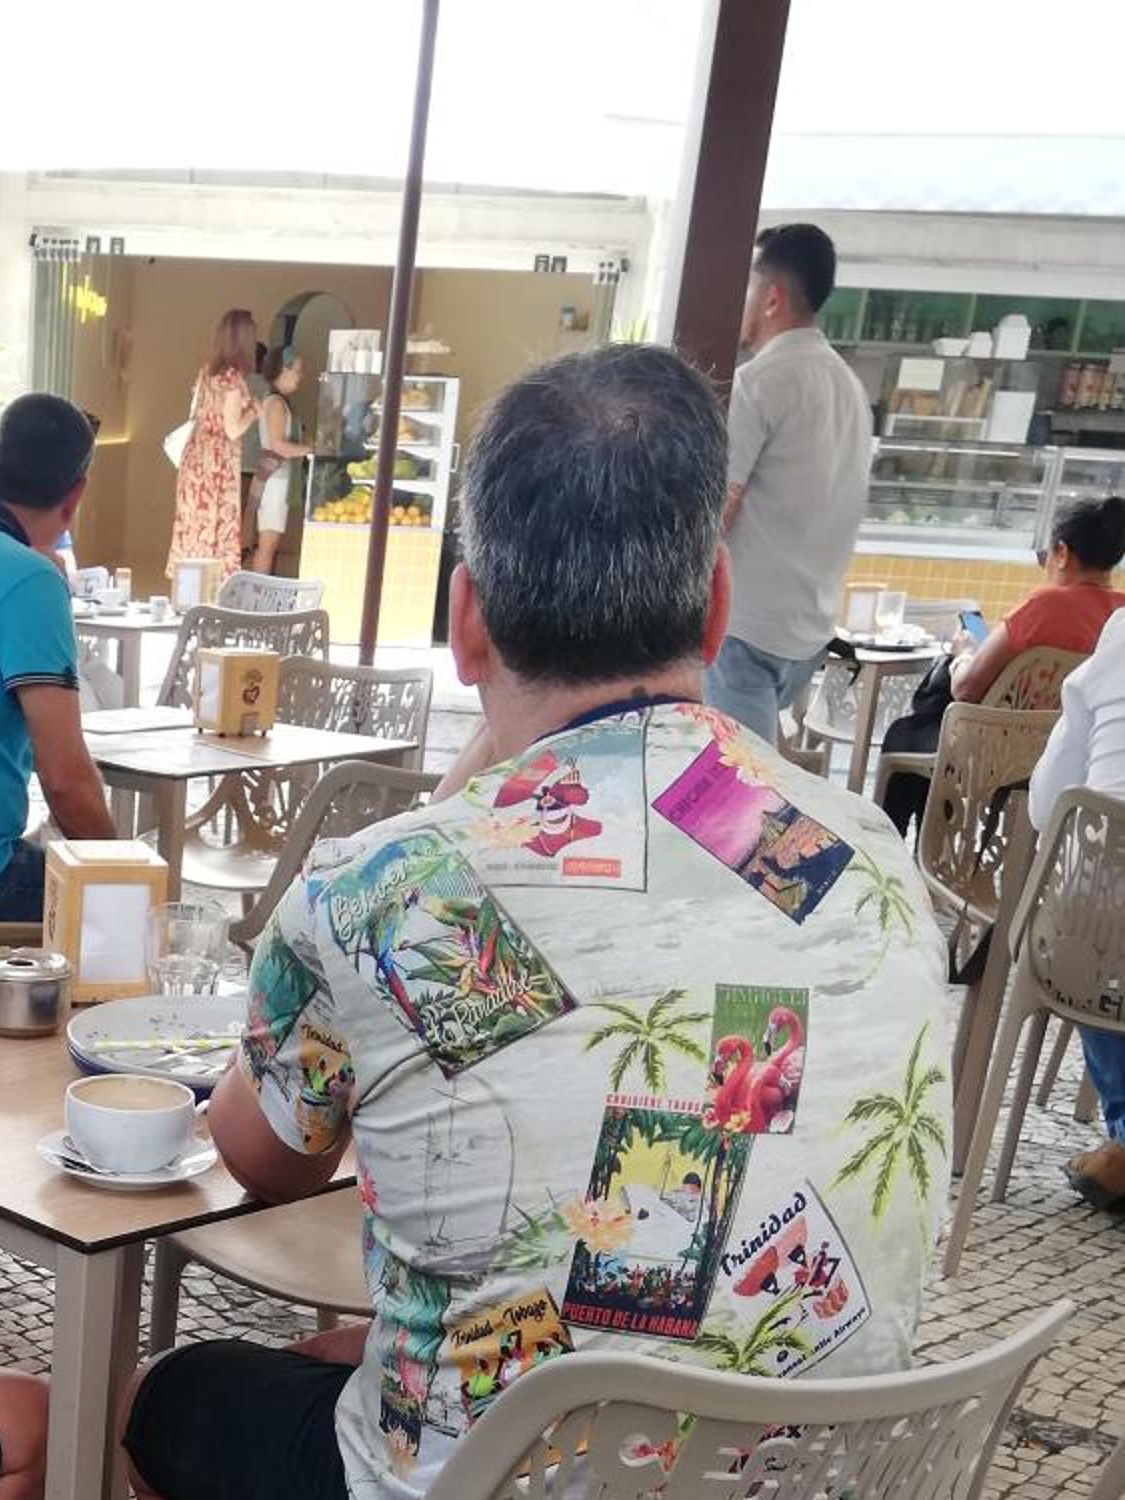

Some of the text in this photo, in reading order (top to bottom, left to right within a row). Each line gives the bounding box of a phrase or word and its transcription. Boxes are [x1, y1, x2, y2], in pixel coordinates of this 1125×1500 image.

[451, 971, 535, 1030] Paradise
[721, 1191, 808, 1276] Trinidad
[451, 1320, 495, 1346] Trinidad
[502, 1299, 548, 1327] Tobago
[563, 1301, 698, 1339] PUERTO DE LA HABANA
[832, 1306, 868, 1340] Airways
